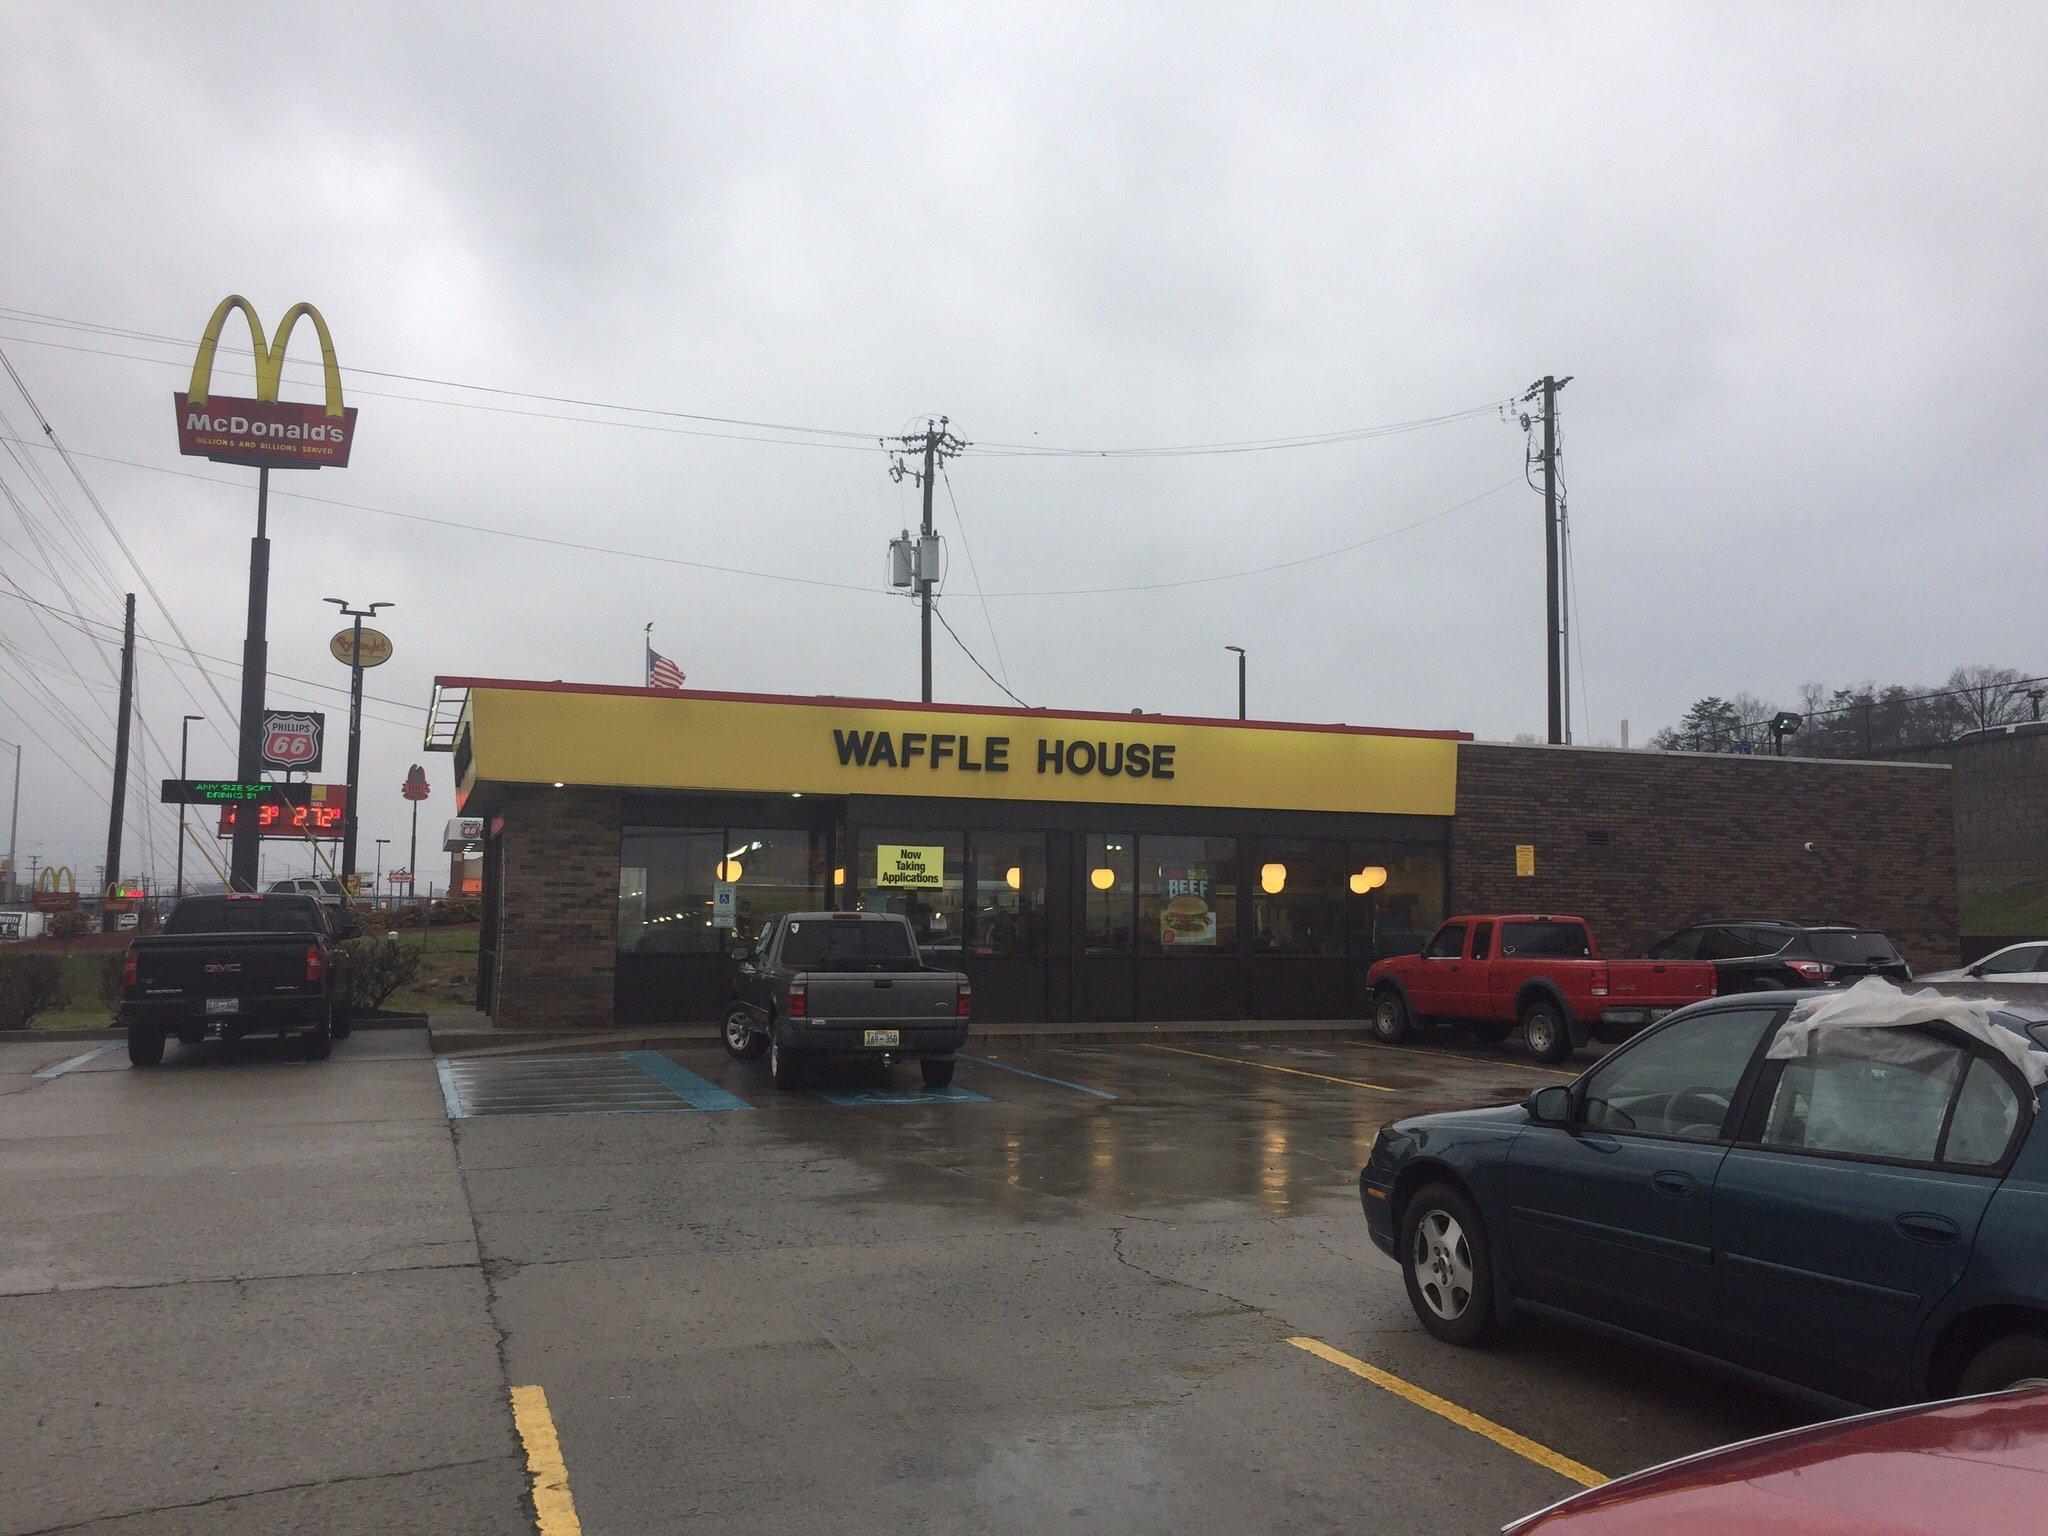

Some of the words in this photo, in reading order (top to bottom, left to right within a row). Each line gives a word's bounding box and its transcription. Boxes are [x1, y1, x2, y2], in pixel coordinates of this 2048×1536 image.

[186, 413, 345, 443] McDonald's
[196, 437, 235, 448] BILLIONS
[239, 440, 256, 449] AND
[260, 443, 297, 453] BILLIONS
[302, 446, 333, 455] SERVED
[272, 722, 311, 734] PHILLIPS
[273, 735, 308, 755] 66
[833, 729, 1010, 773] WAFFLE
[1037, 738, 1177, 779] HOUSE
[195, 783, 219, 791] ANY
[900, 849, 922, 860] Now
[896, 860, 926, 874] Taking
[882, 872, 939, 884] Applications
[1168, 879, 1209, 899] BEEF
[205, 963, 243, 973] GMC
